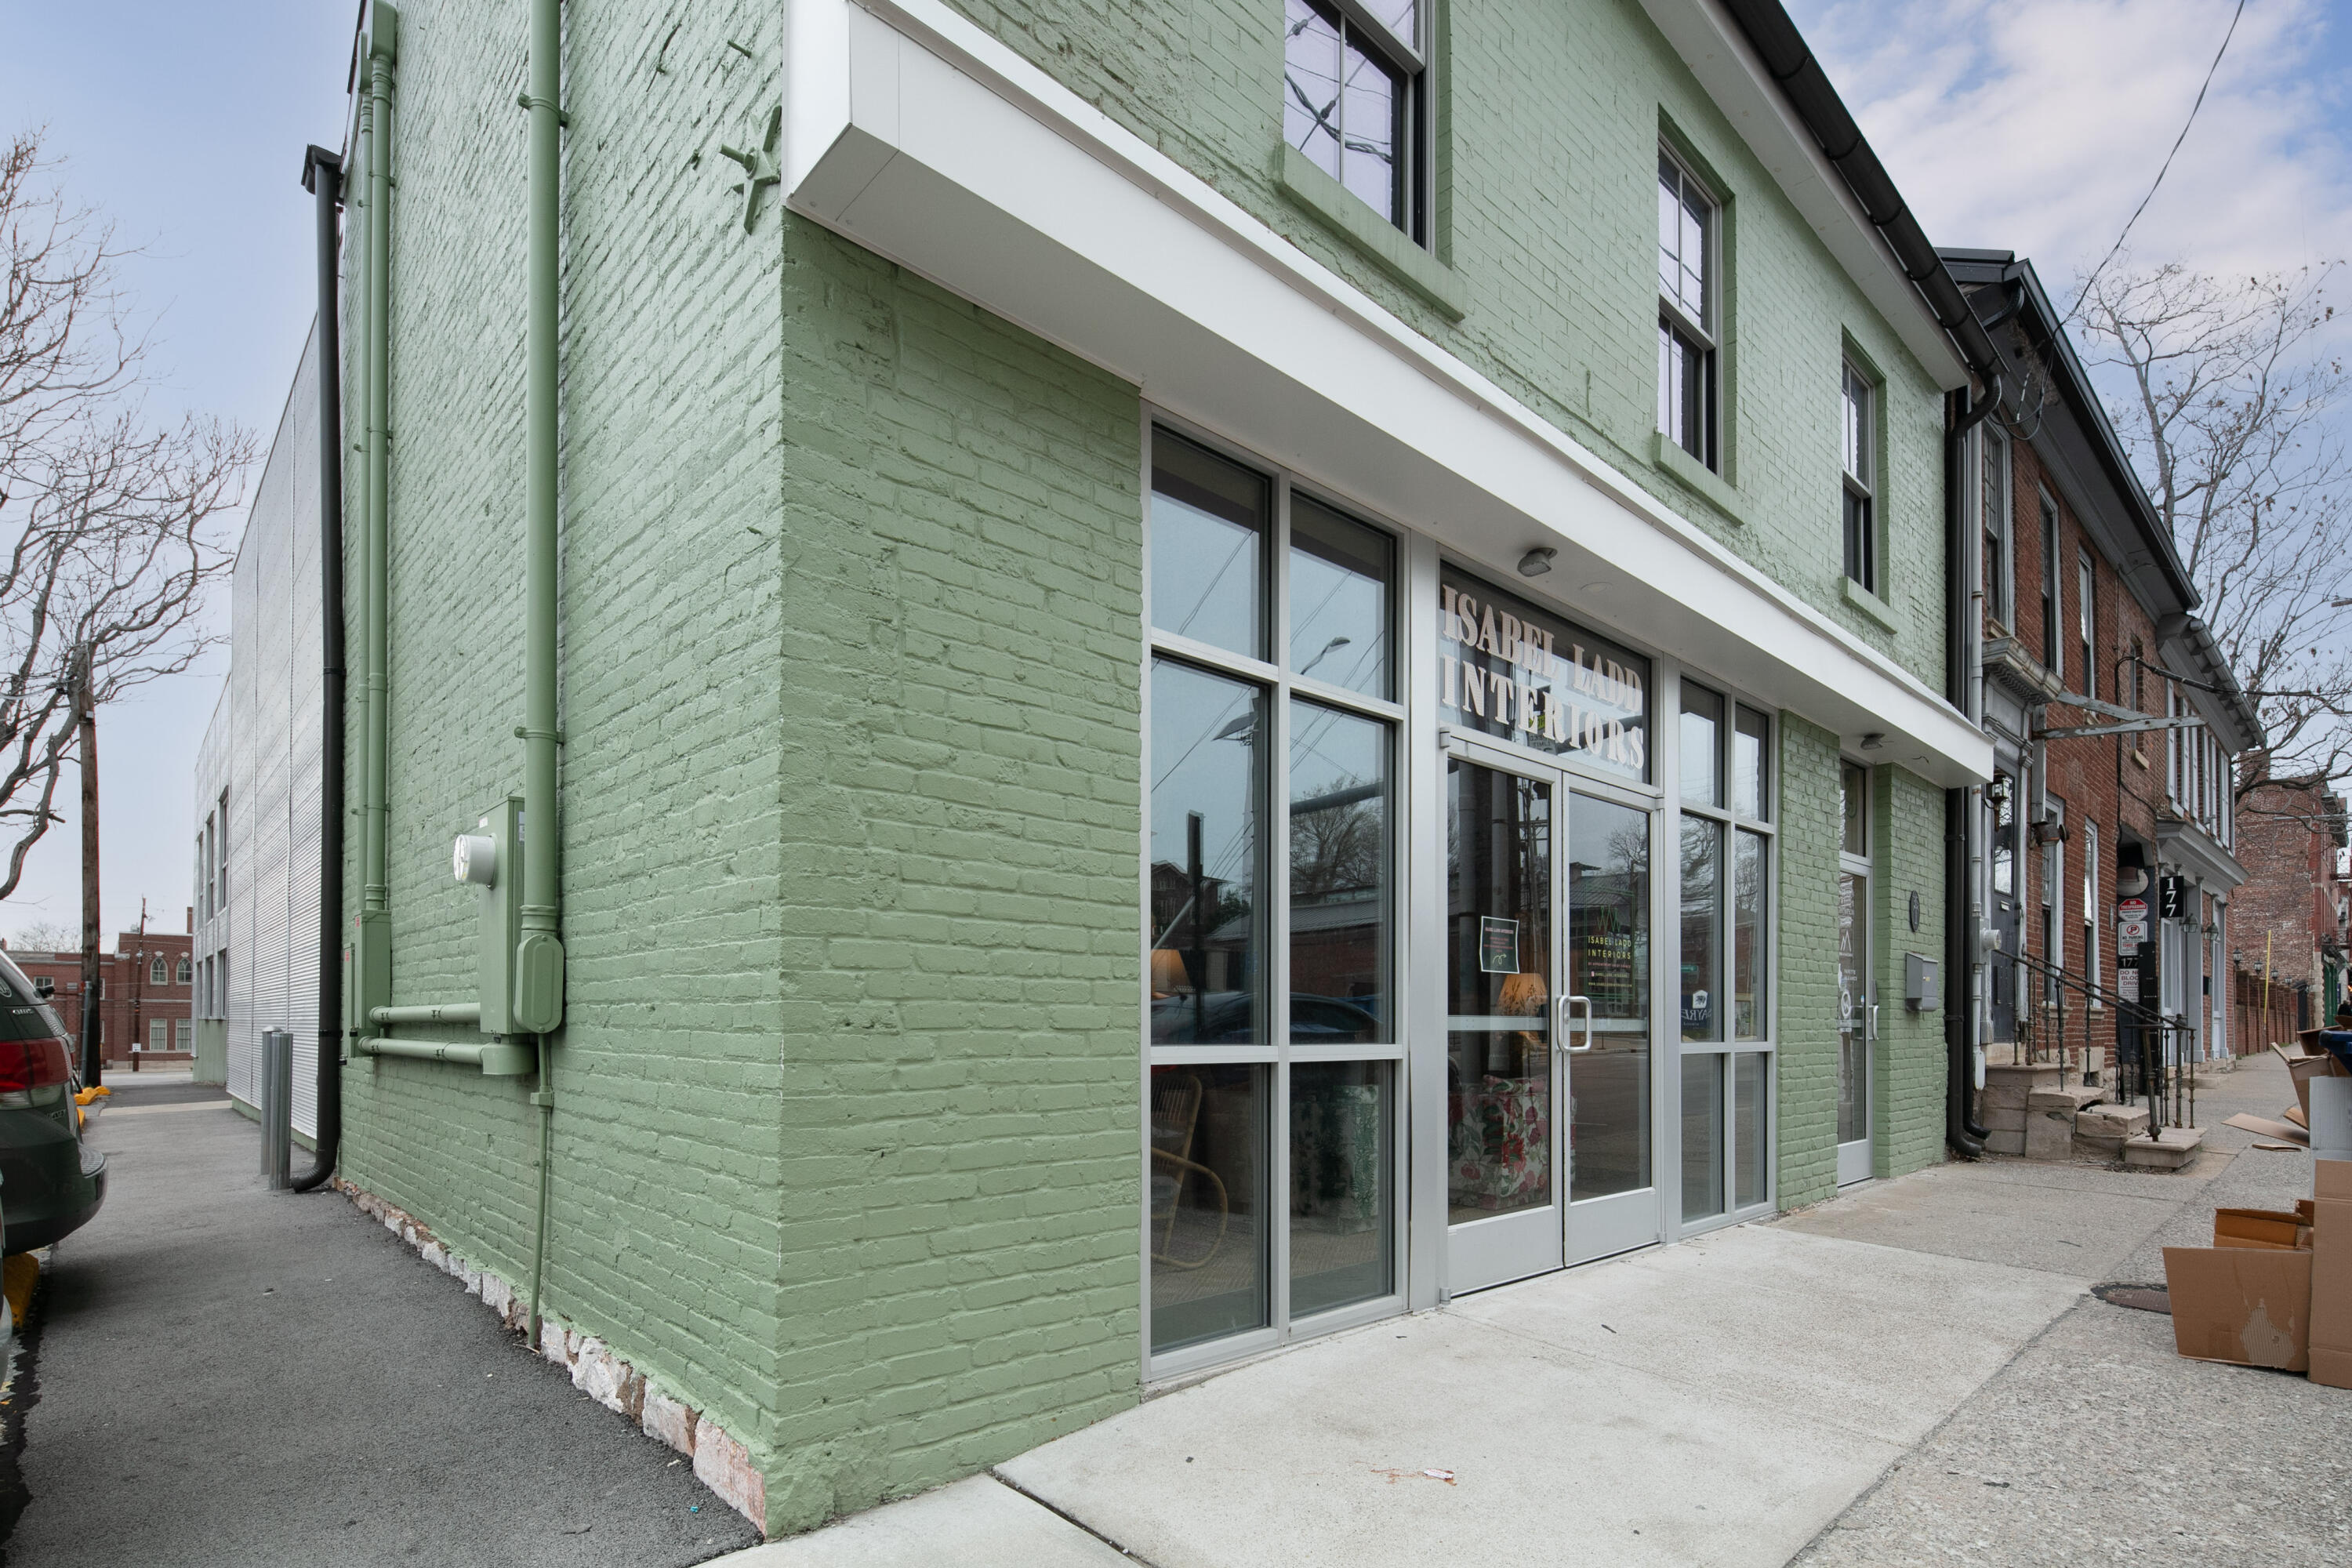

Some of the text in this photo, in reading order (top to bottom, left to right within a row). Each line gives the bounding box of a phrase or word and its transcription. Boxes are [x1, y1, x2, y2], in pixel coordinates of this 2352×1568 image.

[1443, 584, 1643, 713] ISABEL LADD
[1442, 652, 1644, 770] INTERIORS
[2165, 877, 2176, 916] 177
[1588, 935, 1632, 947] ISABEL LADD
[1588, 949, 1631, 959] INTERIORS
[2121, 957, 2139, 967] 177
